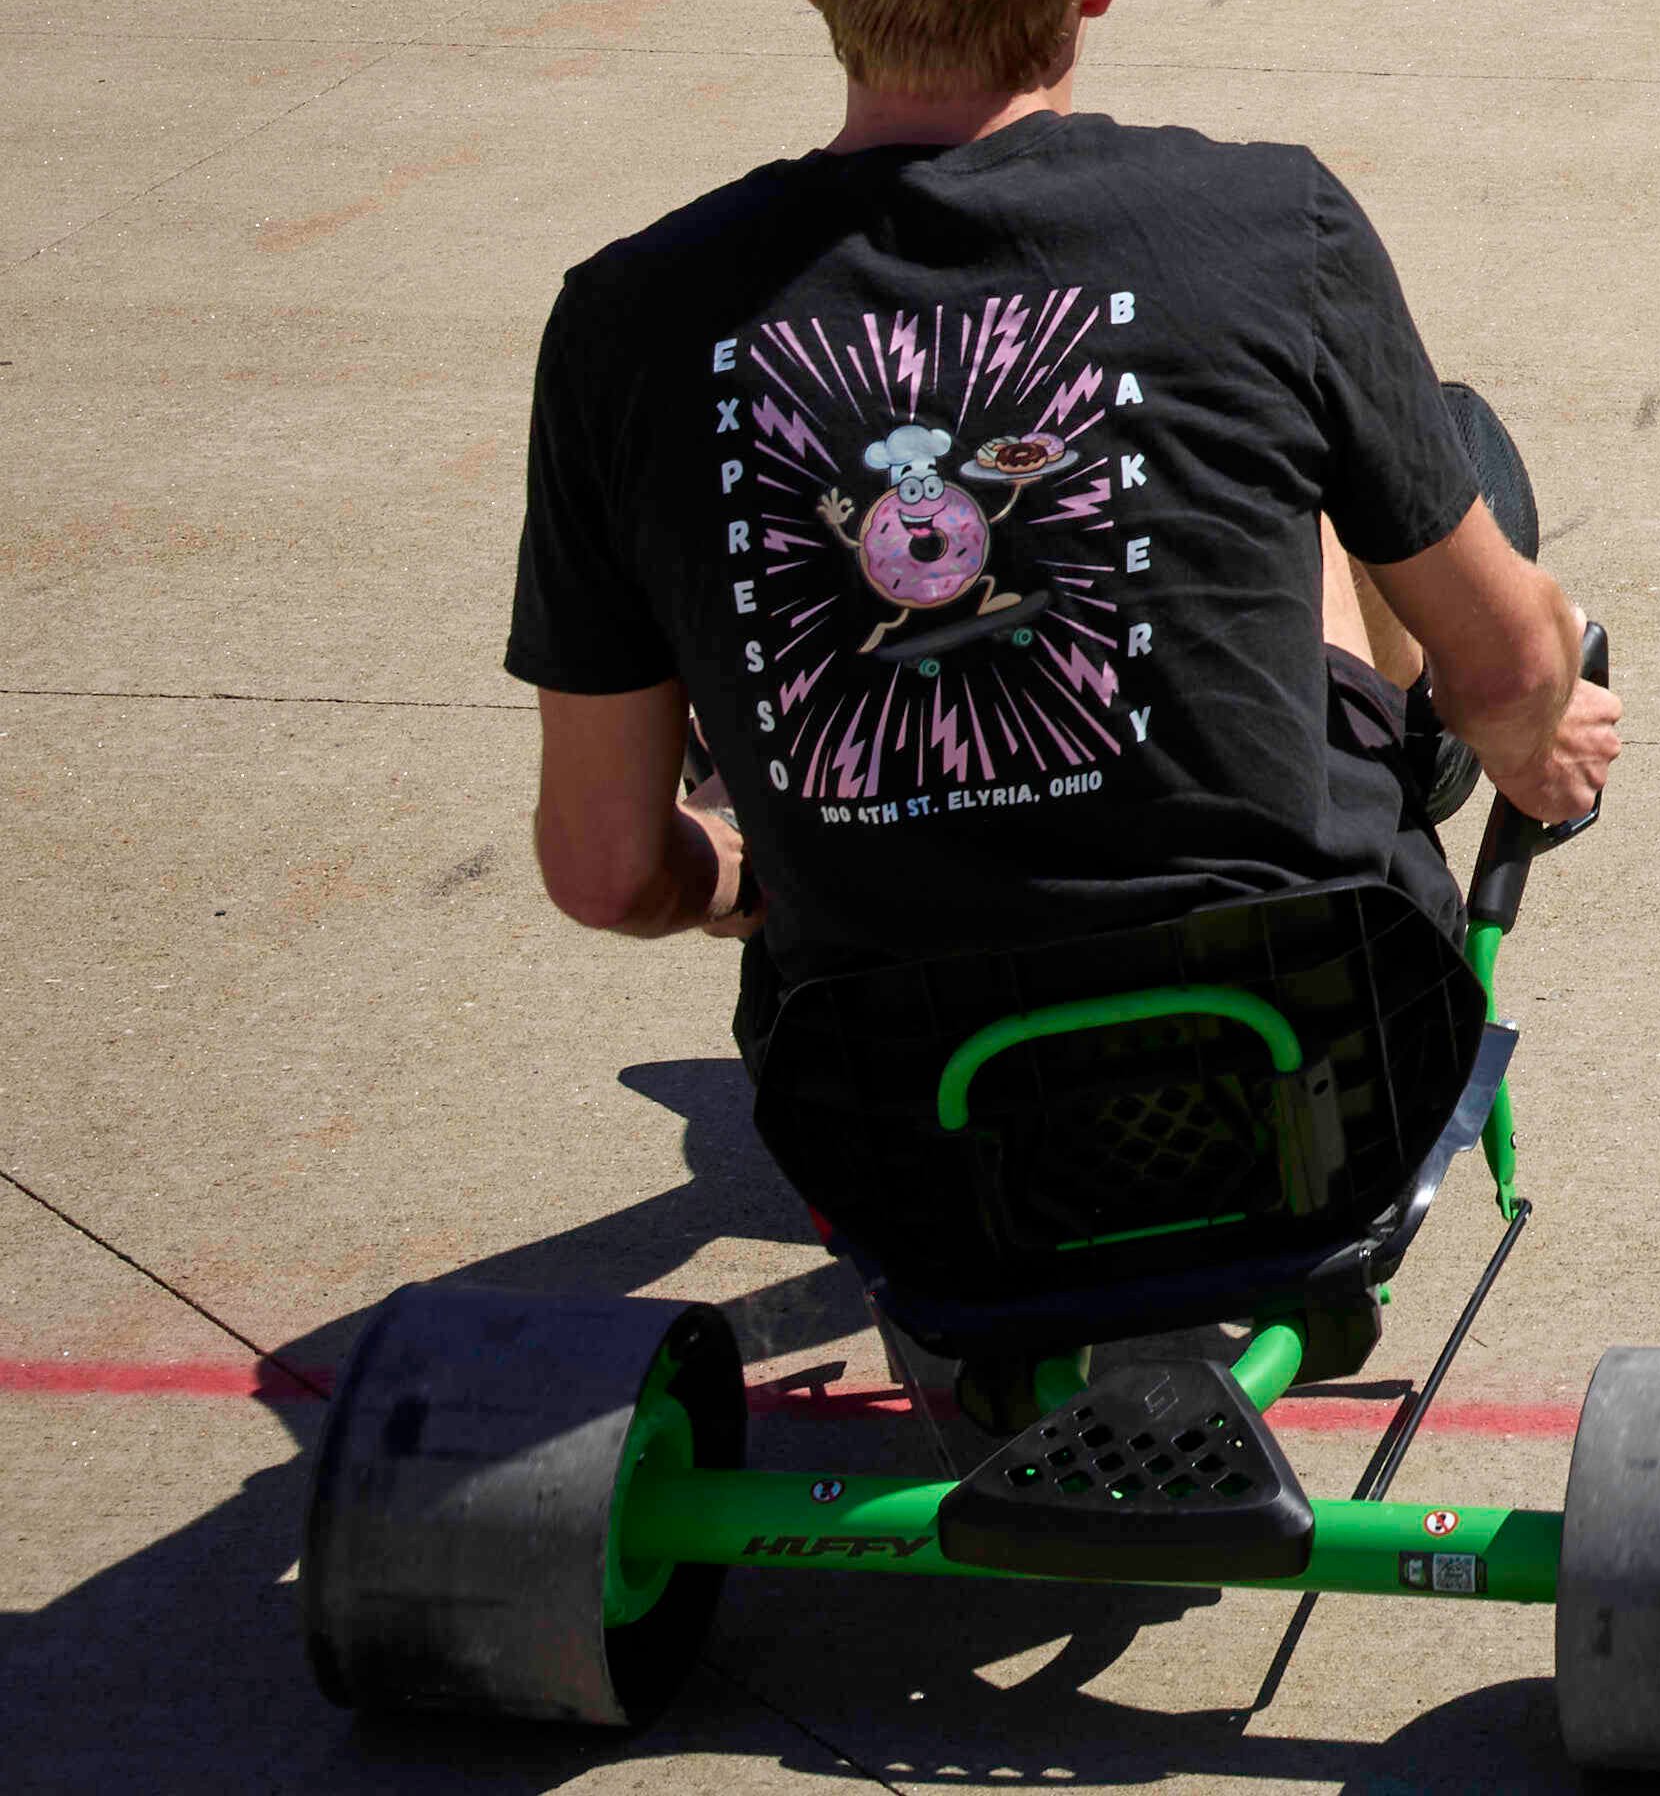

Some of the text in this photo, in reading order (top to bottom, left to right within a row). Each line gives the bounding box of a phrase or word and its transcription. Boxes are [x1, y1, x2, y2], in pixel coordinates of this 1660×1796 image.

[712, 338, 789, 791] EXPRESSO
[1110, 291, 1152, 743] BAKERY
[821, 770, 1103, 824] 100 4TH ST. ELYRIA, OHIO
[741, 1535, 935, 1558] HUFFY
